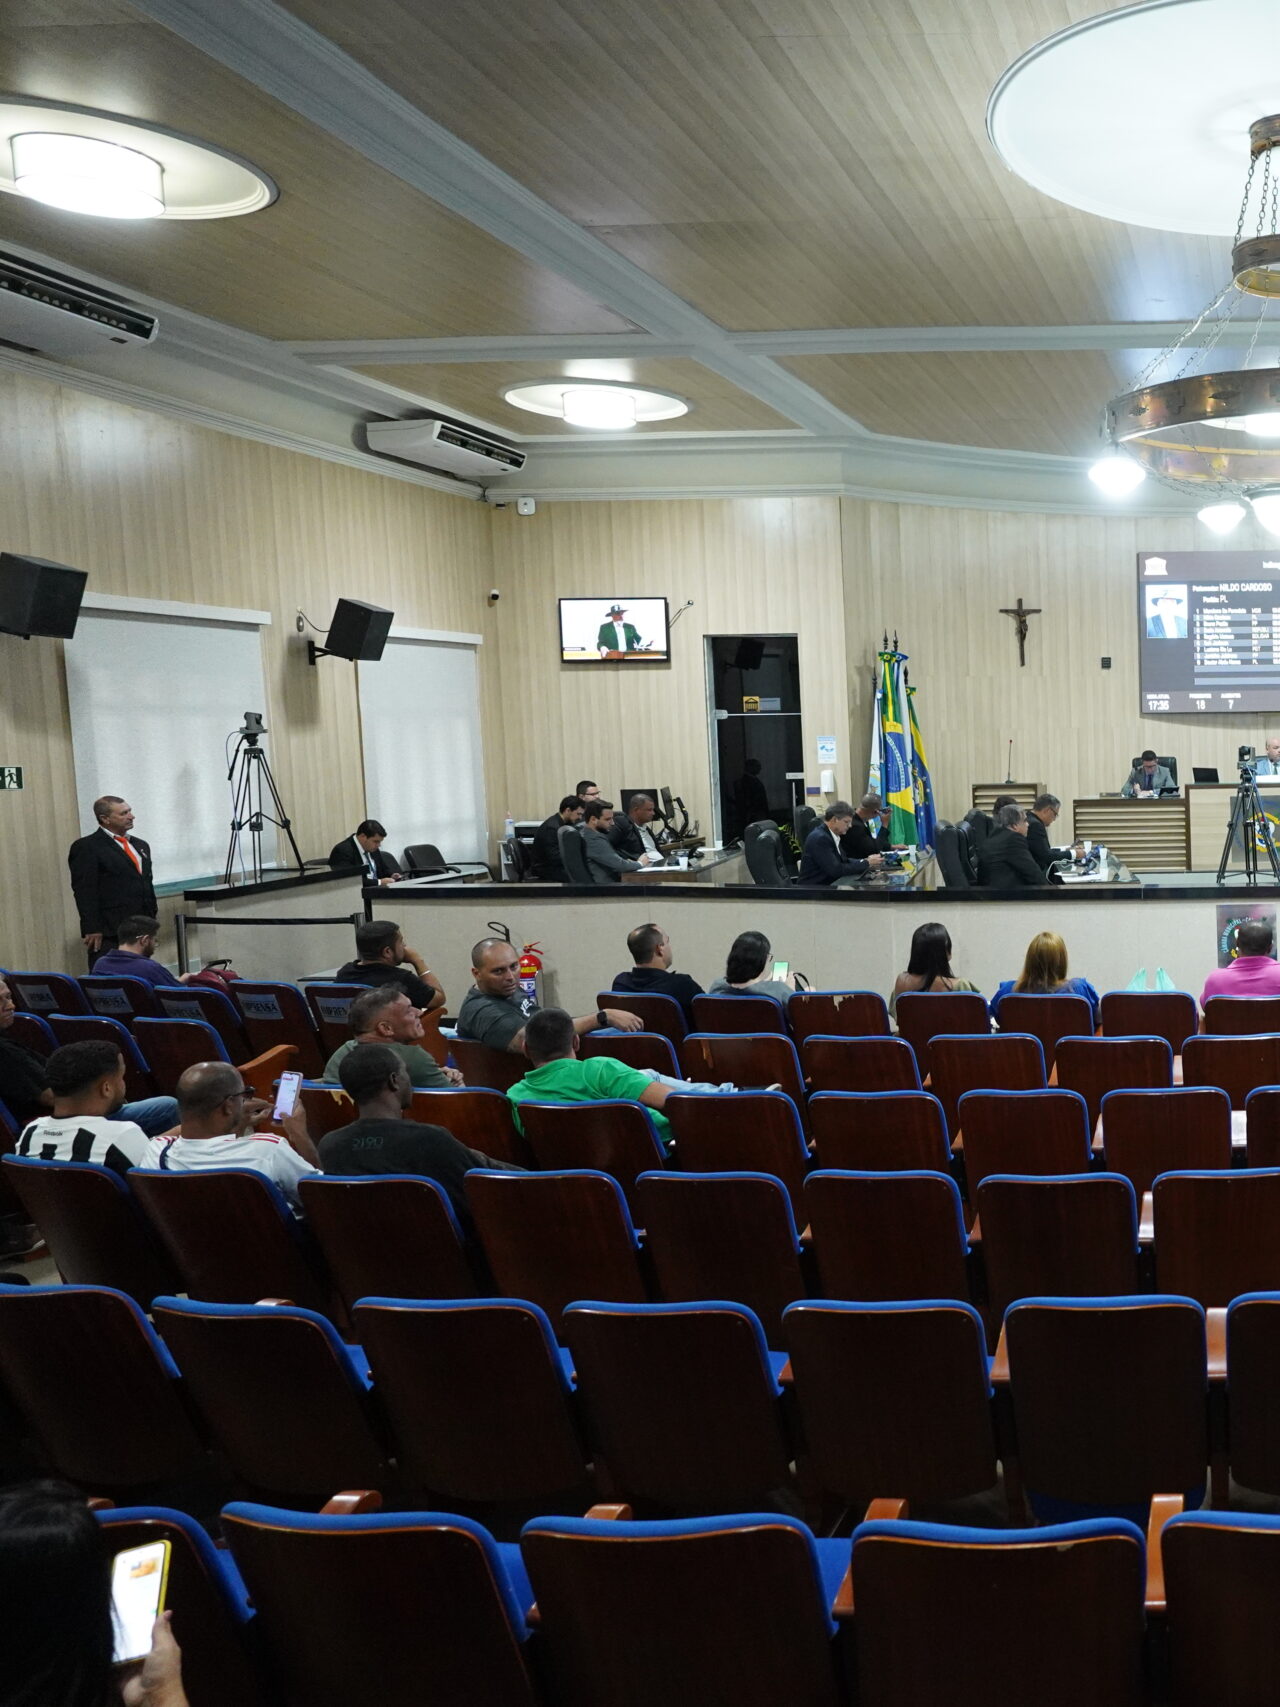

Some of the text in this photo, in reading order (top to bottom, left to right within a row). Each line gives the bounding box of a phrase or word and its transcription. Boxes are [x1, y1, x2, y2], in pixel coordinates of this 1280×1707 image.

[1219, 583, 1240, 592] NILDO
[1240, 582, 1273, 592] CARDOSO
[1228, 699, 1234, 710] 7
